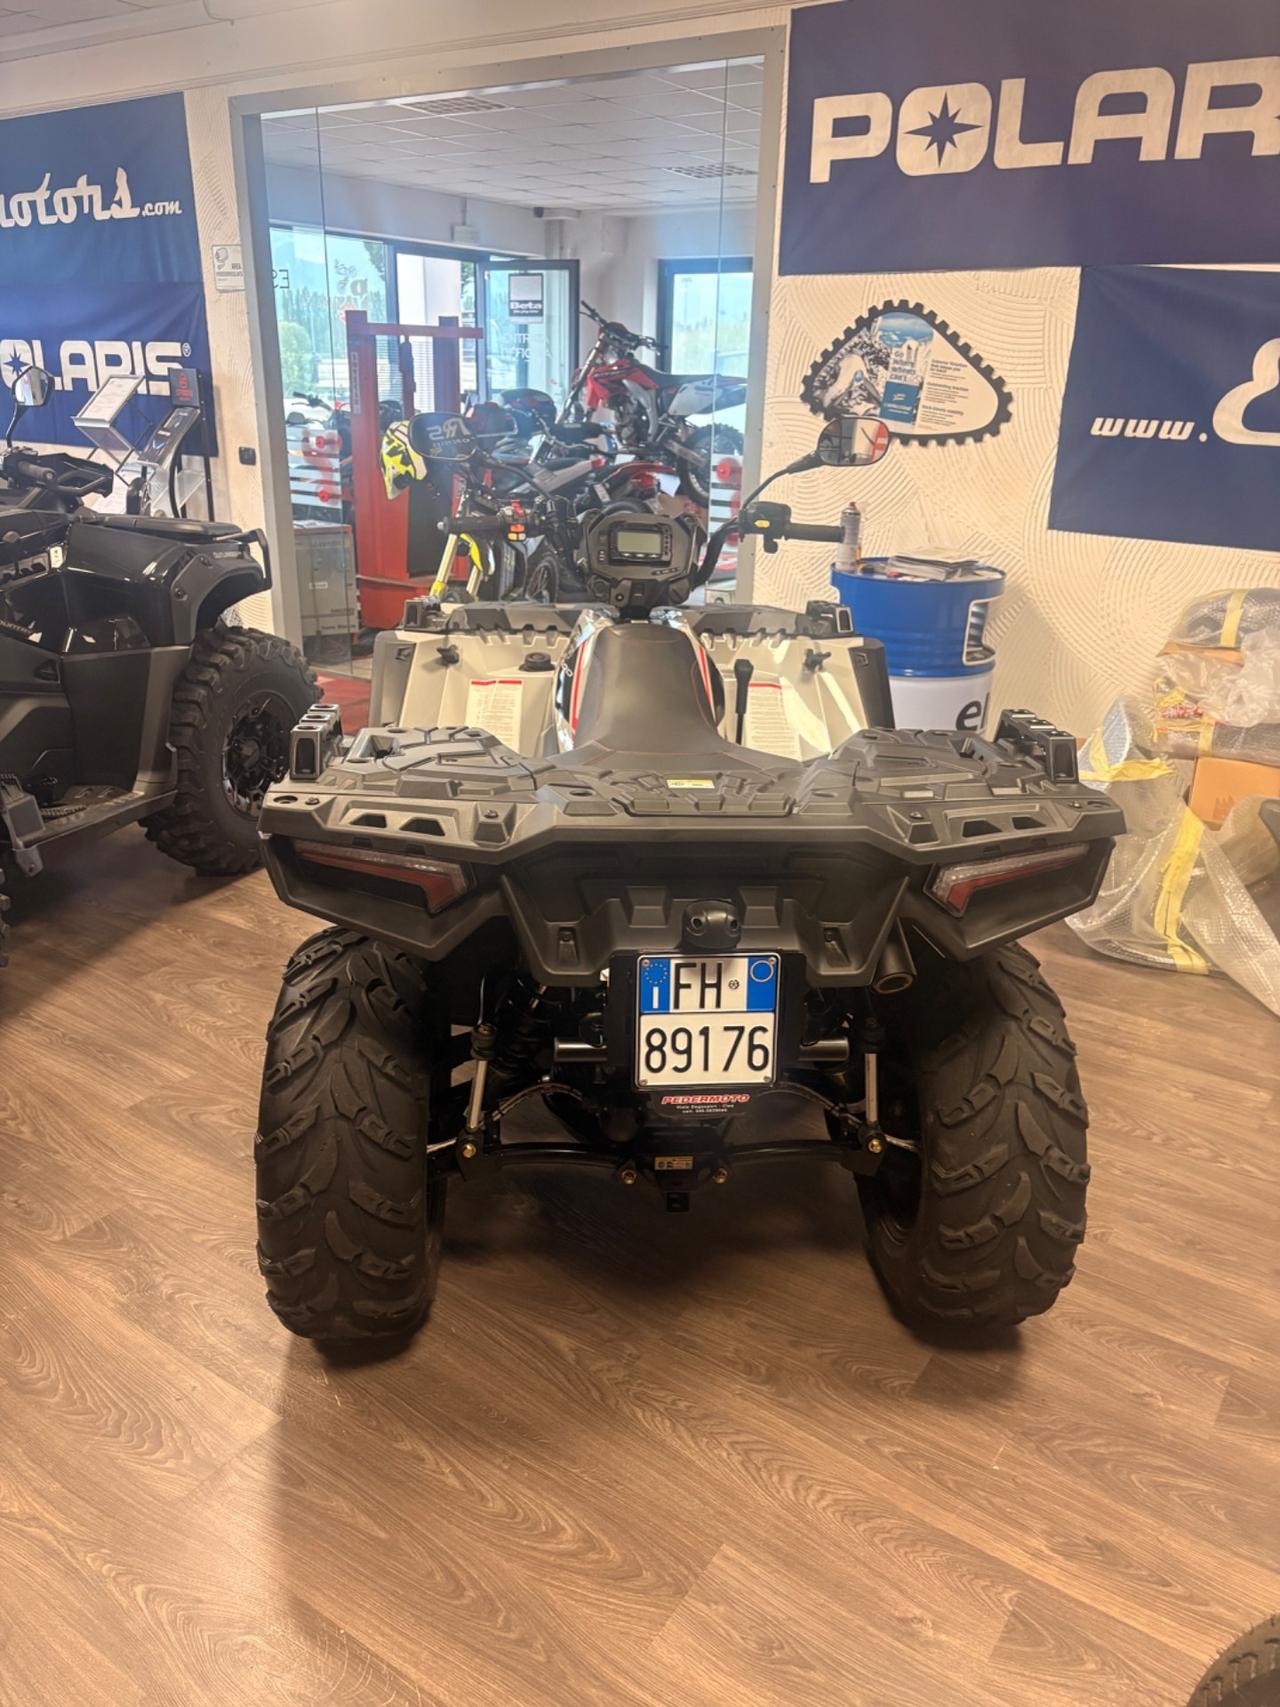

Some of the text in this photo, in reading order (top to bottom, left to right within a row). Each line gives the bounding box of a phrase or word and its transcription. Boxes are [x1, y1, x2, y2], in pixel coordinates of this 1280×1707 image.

[673, 962, 723, 1010] FH
[644, 1025, 770, 1074] 89176
[661, 1093, 751, 1105] PEDERMOTO
